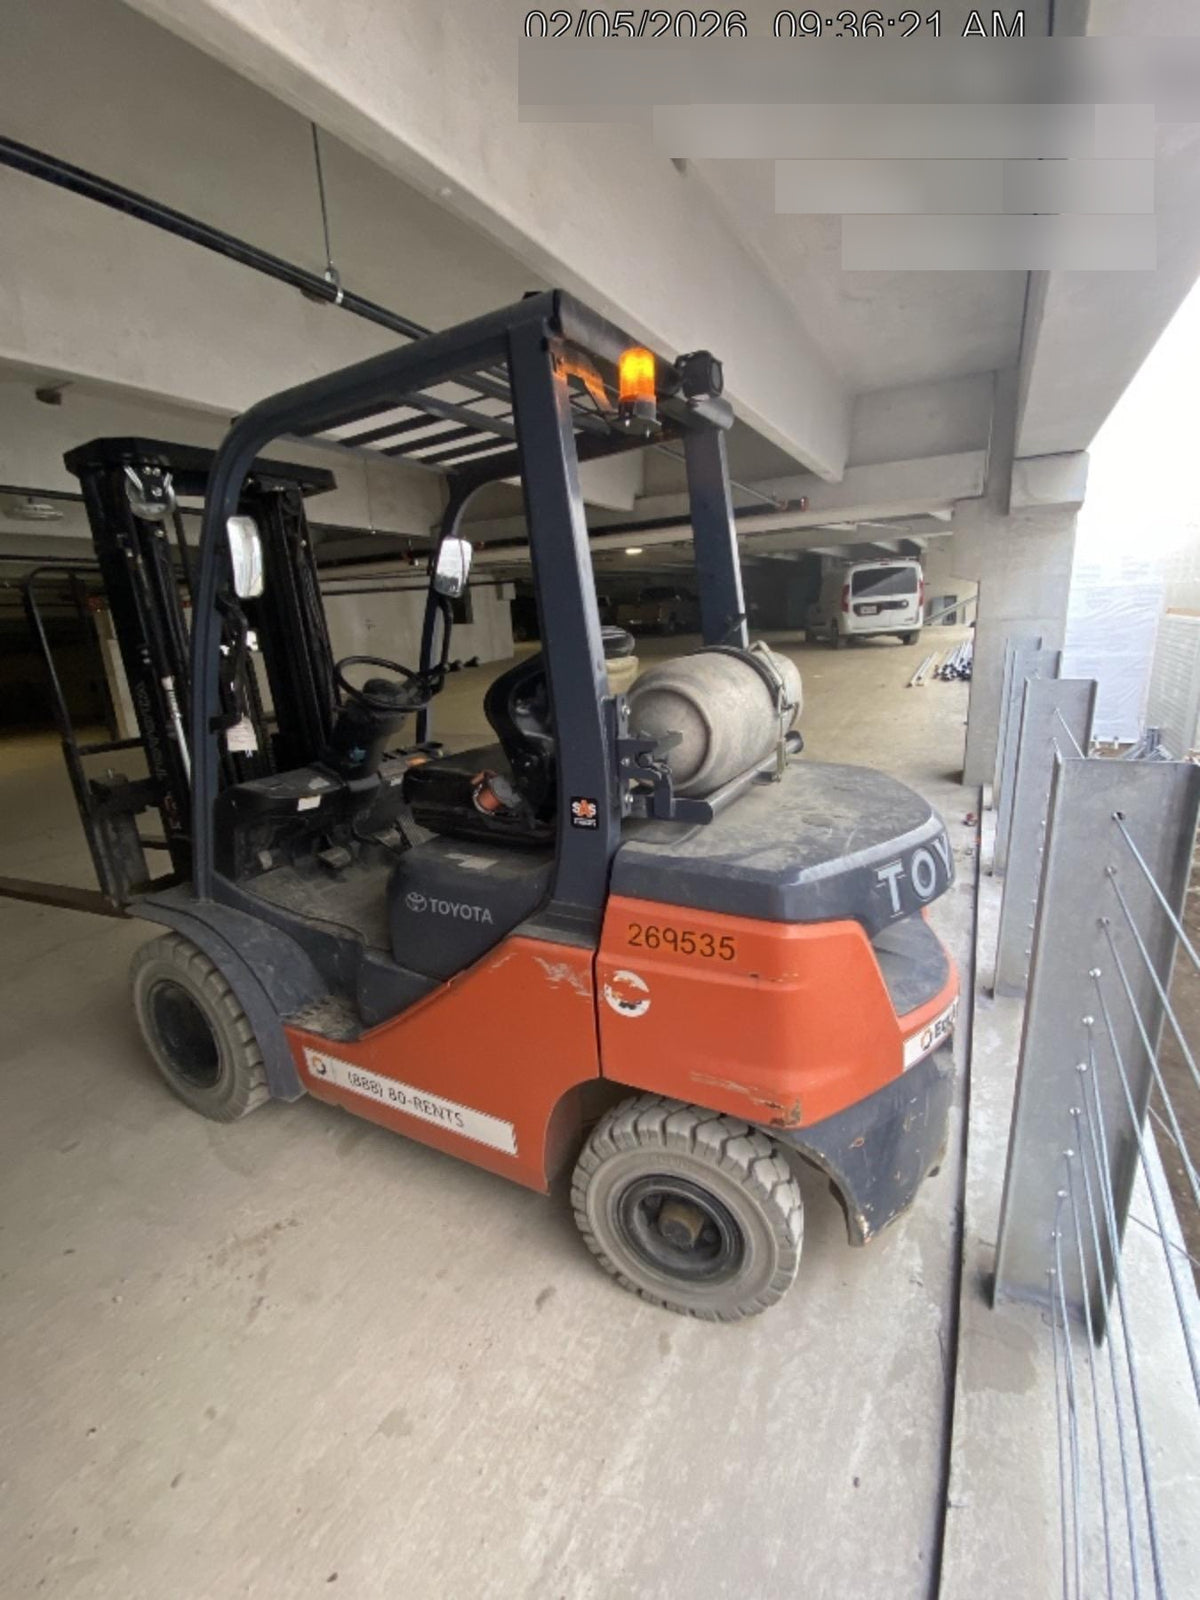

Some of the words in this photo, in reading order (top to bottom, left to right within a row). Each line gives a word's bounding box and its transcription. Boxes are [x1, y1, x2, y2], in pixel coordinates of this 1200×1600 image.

[878, 832, 952, 913] TOY
[429, 897, 494, 925] TOYOTA
[627, 922, 736, 961] 269535
